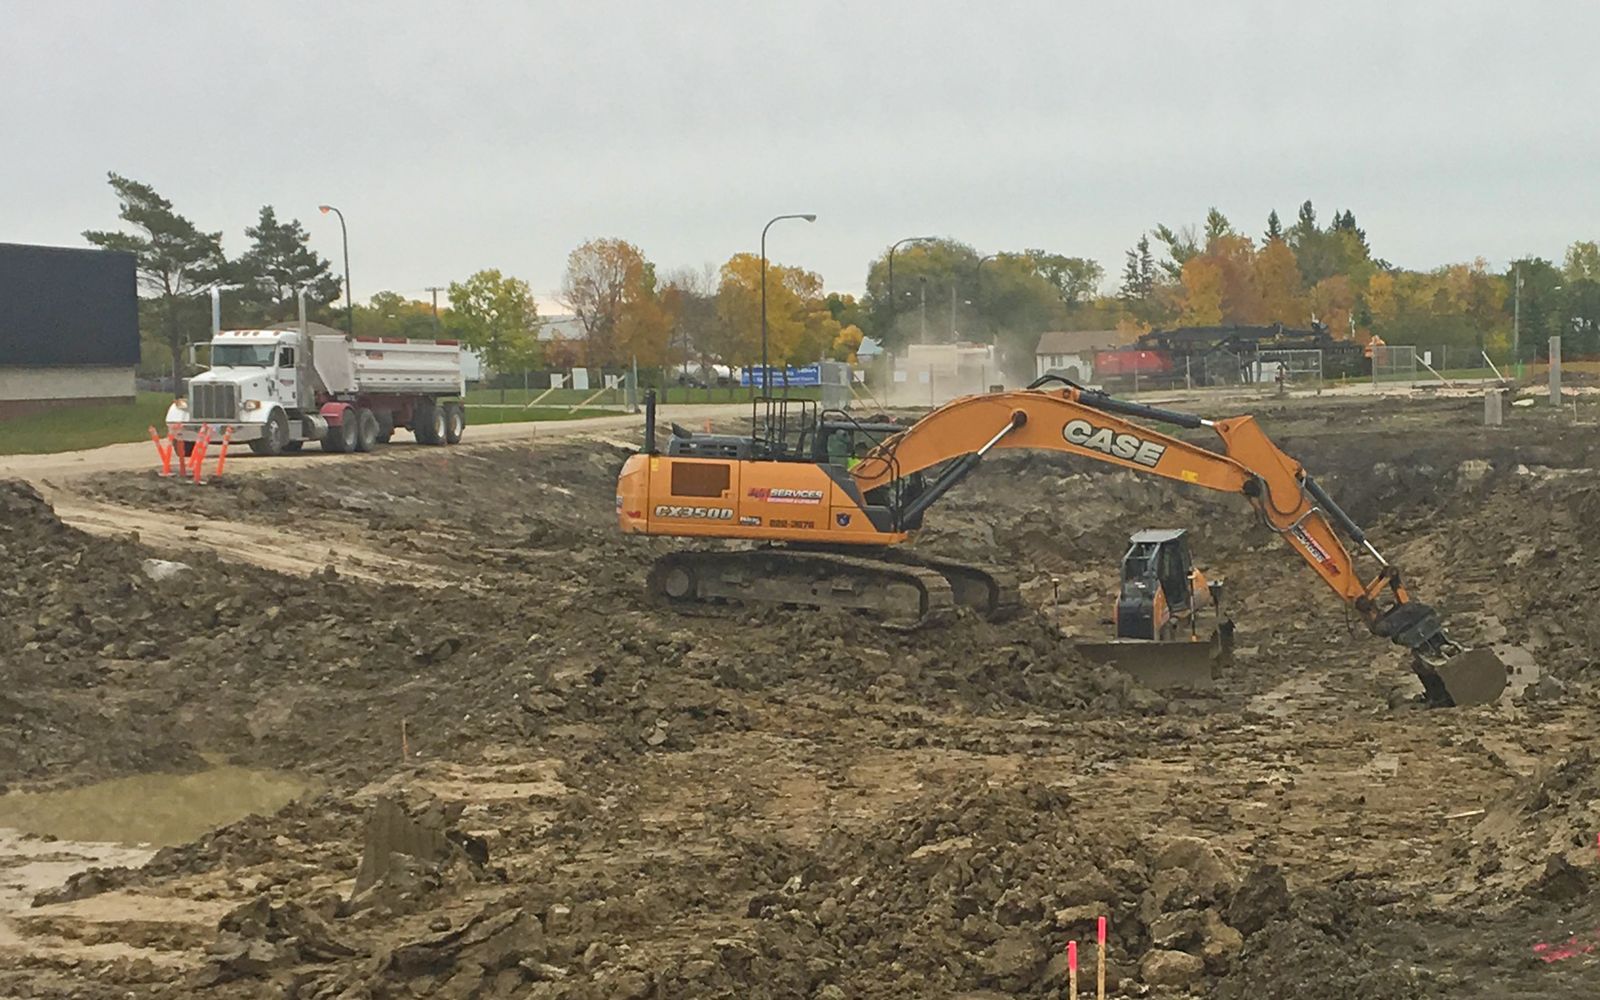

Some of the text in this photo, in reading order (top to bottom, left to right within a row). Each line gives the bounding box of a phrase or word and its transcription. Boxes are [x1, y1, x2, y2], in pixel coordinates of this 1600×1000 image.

[1063, 419, 1166, 467] CASE
[770, 488, 823, 499] SERVICES
[655, 505, 734, 519] CX350D
